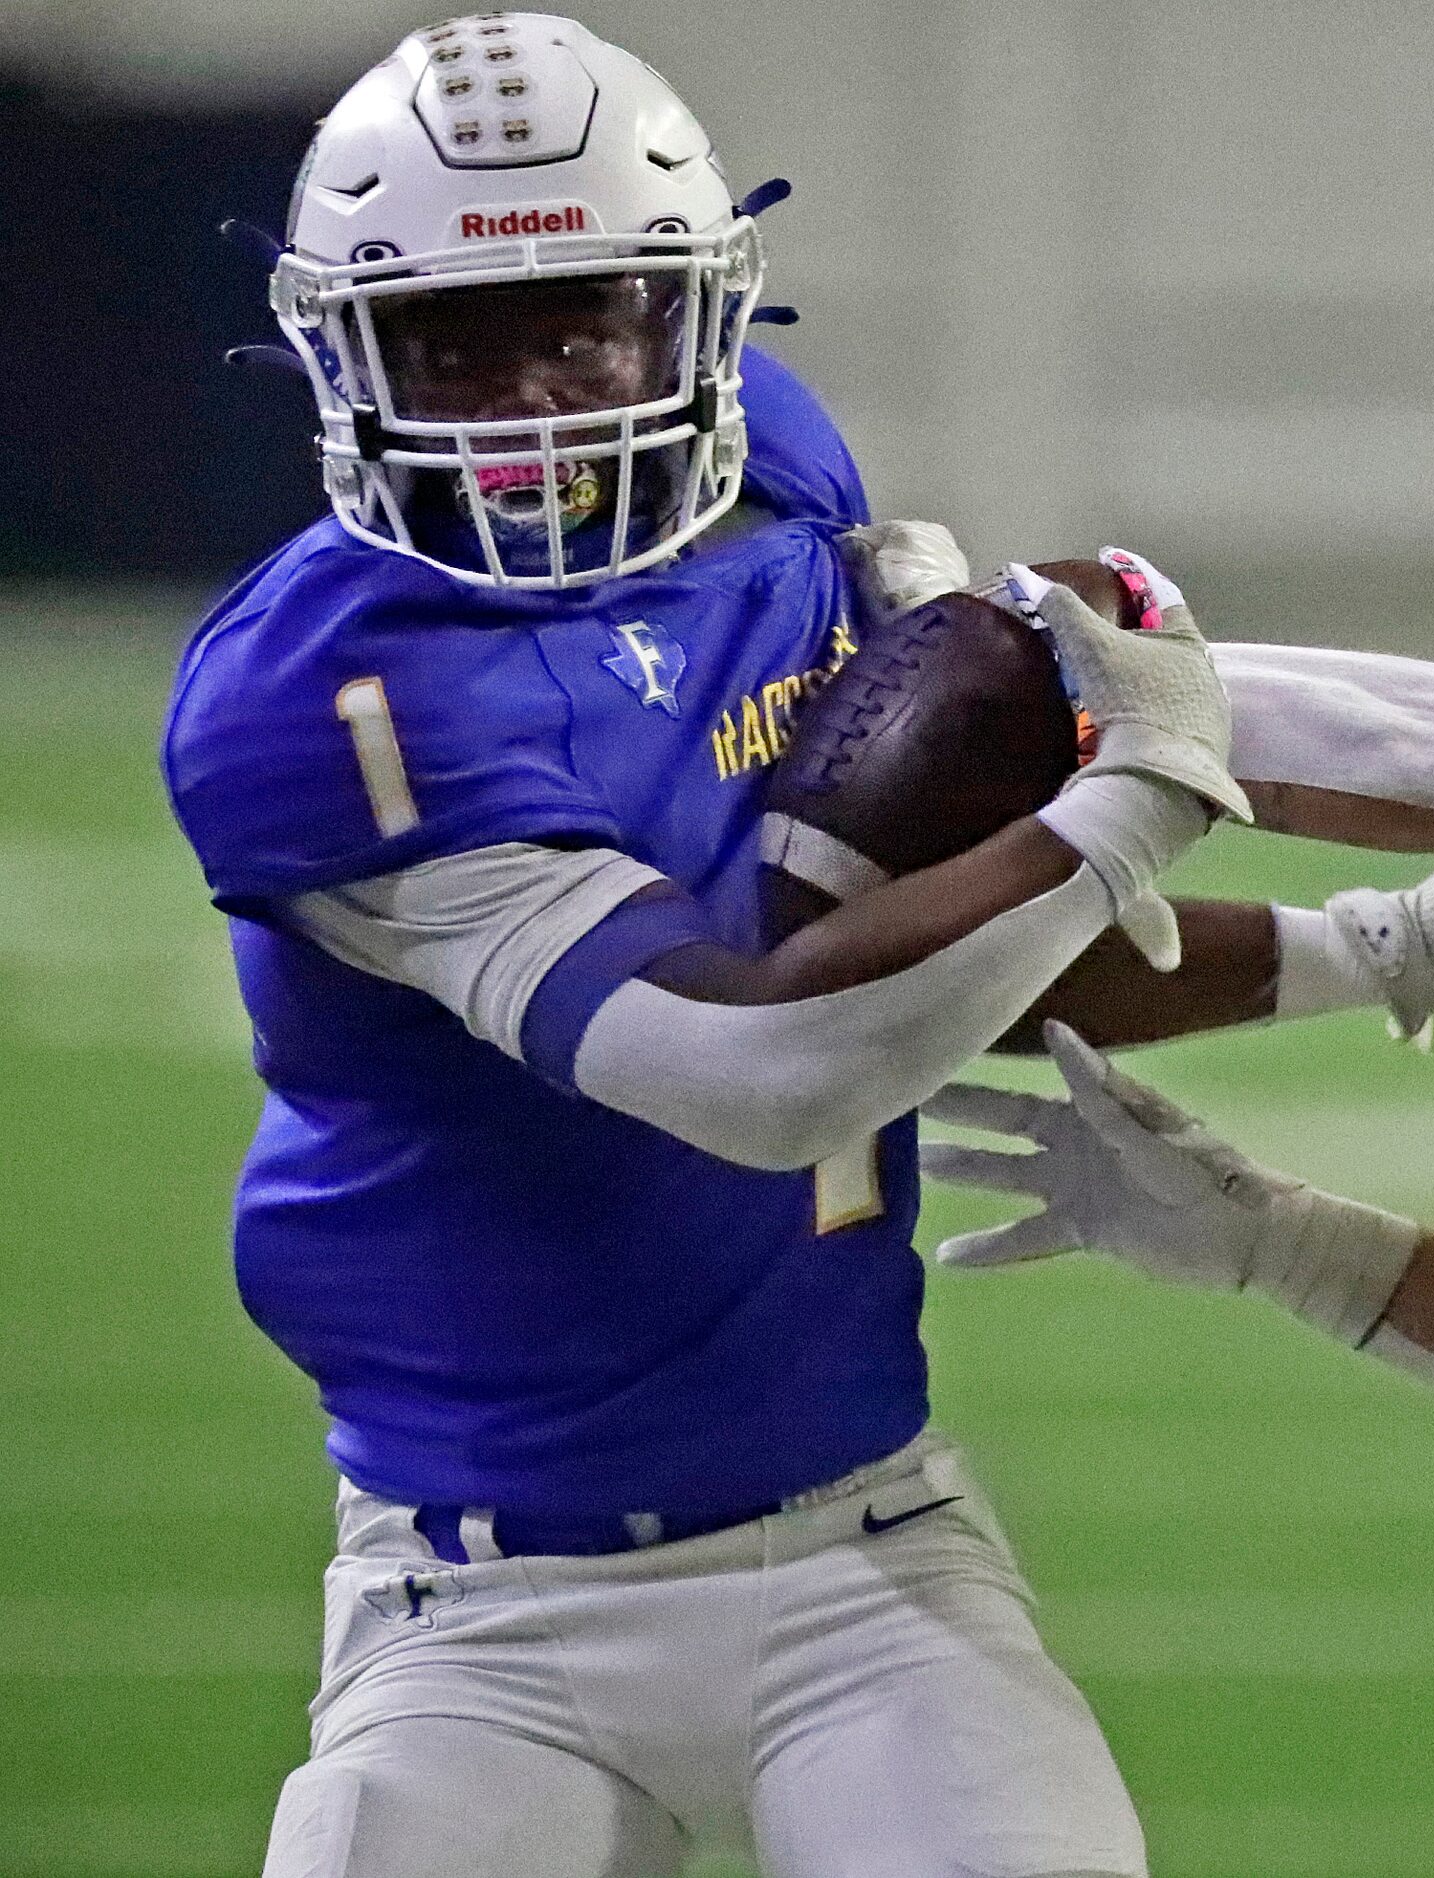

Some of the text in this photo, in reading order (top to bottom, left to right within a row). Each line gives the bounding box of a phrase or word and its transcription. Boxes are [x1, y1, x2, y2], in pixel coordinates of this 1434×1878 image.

[461, 206, 584, 237] Riddell
[616, 621, 670, 700] F
[335, 676, 420, 839] 1
